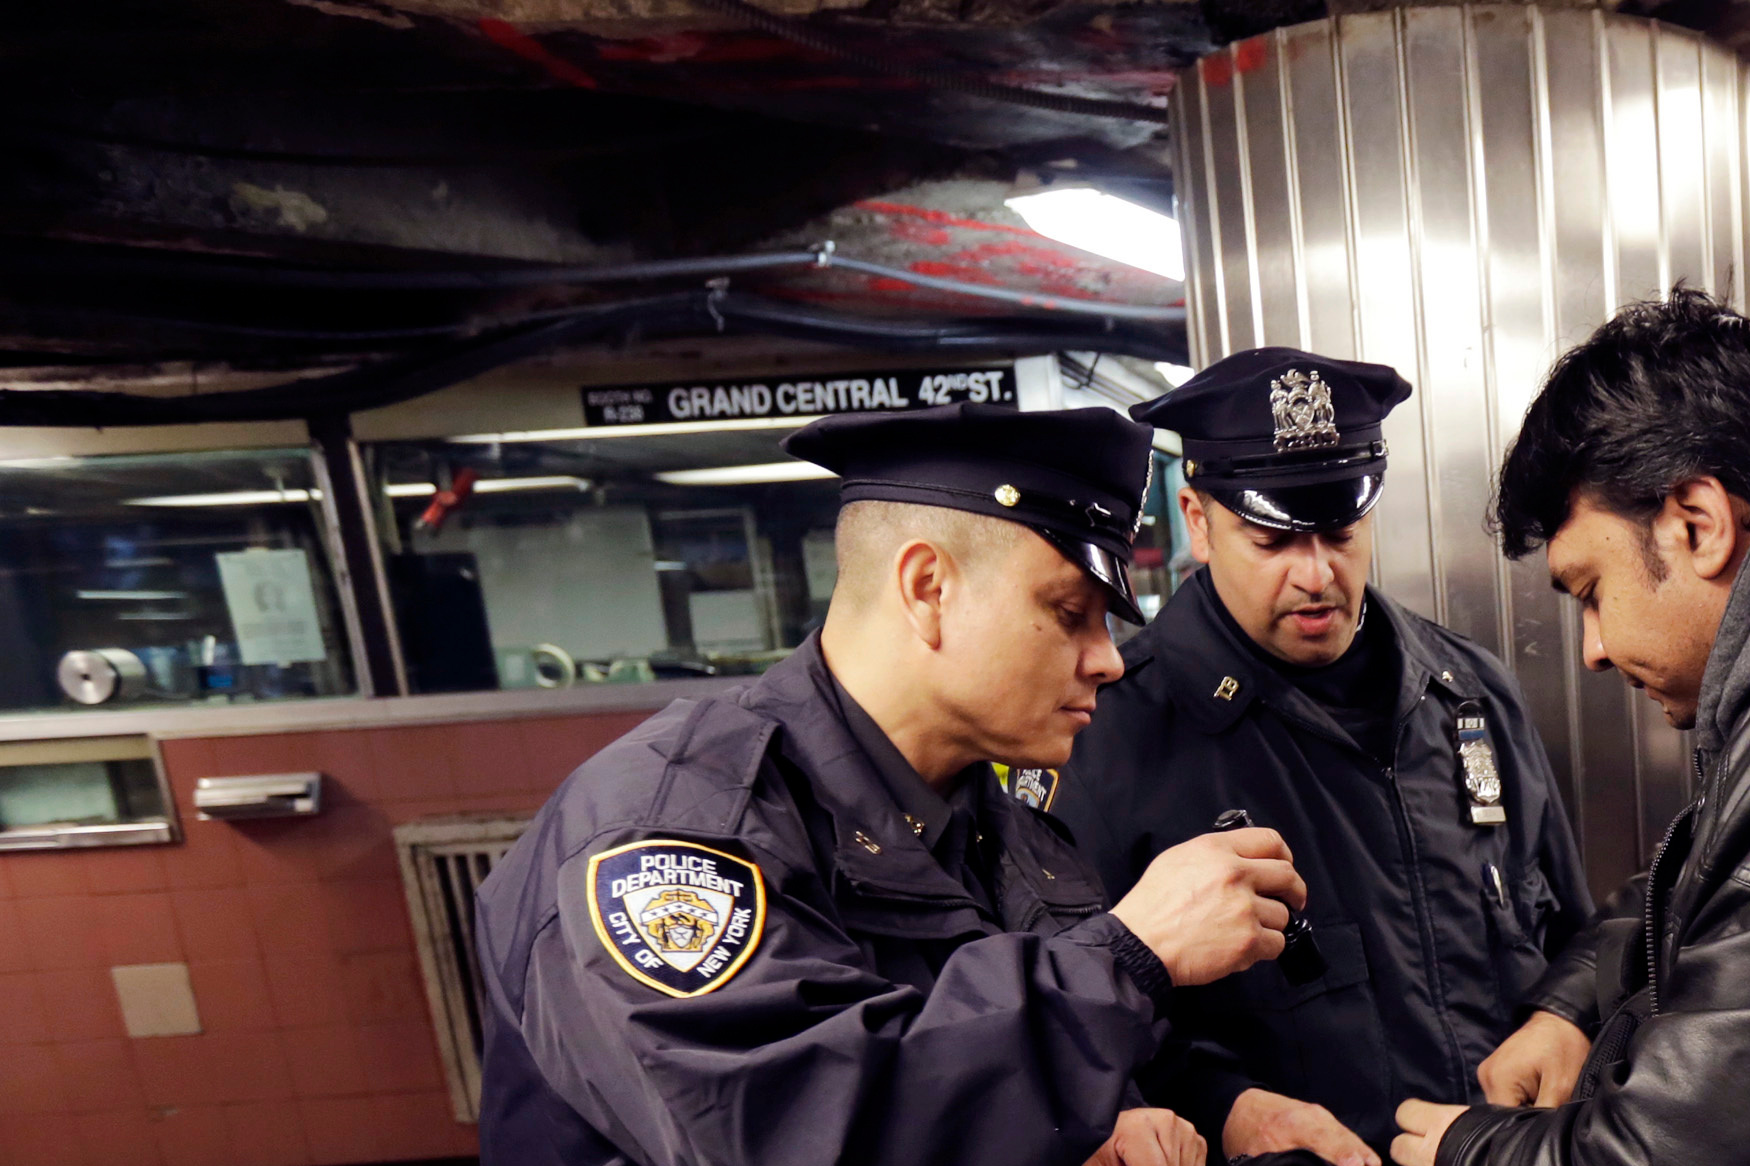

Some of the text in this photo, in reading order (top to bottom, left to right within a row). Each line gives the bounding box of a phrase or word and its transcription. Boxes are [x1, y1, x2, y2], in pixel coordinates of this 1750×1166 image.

[668, 384, 772, 418] GRAND
[776, 377, 909, 413] CENTRAL
[967, 371, 1012, 403] ST.
[612, 869, 744, 898] DEPARTMENT
[641, 854, 717, 875] POLICE
[609, 908, 752, 978] CITY OF NEW YORK
